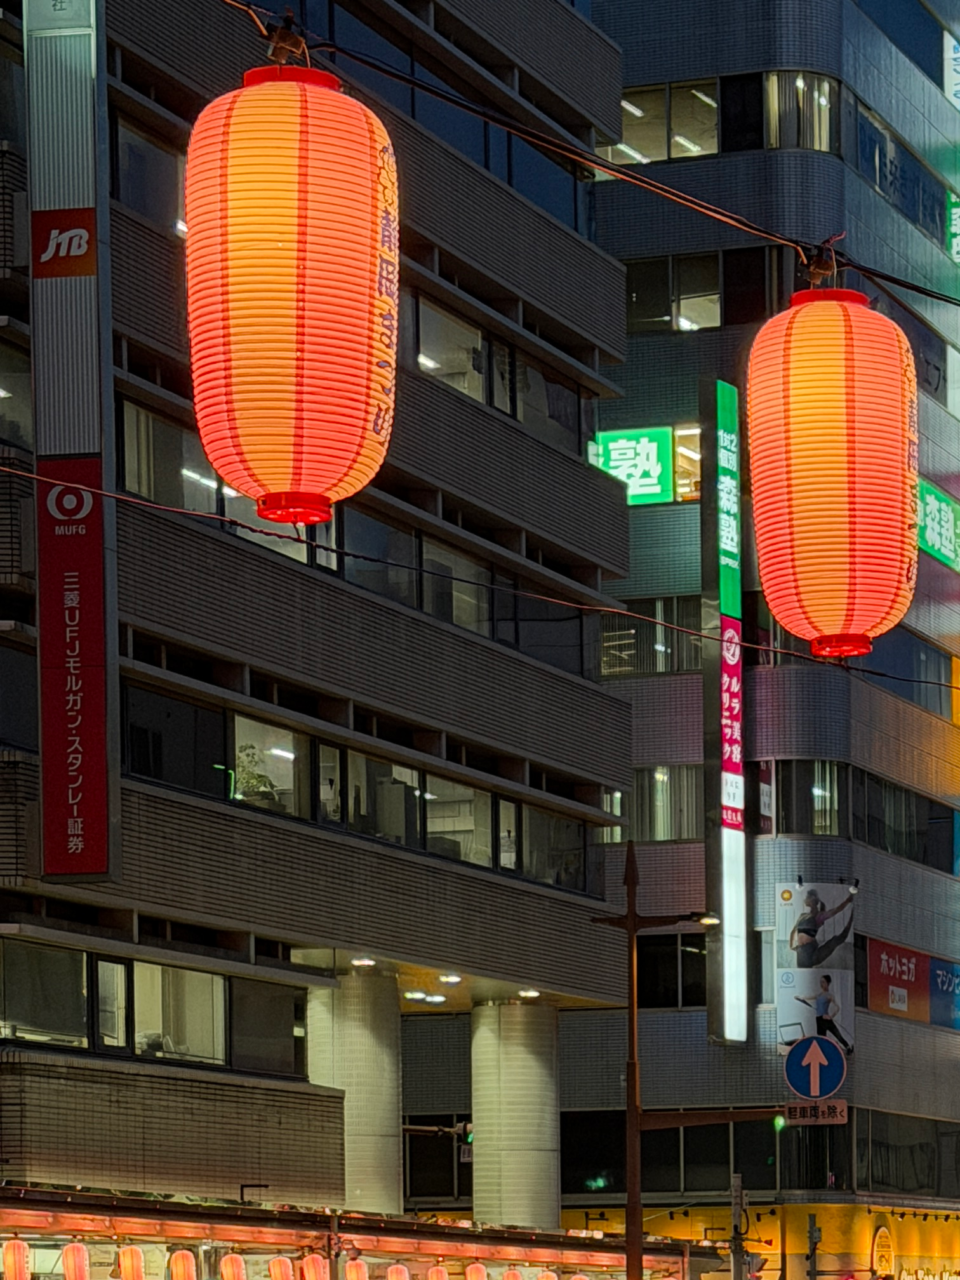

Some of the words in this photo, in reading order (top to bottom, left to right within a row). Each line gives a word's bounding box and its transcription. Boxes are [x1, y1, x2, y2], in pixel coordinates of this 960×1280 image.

[40, 228, 89, 263] JTB
[55, 525, 86, 535] MUFG
[717, 475, 739, 554] 森塾
[63, 571, 85, 854] 三菱UFJモルガン・スタンレー証券
[731, 675, 742, 763] ルラ美容
[880, 951, 916, 982] ホットヨガ
